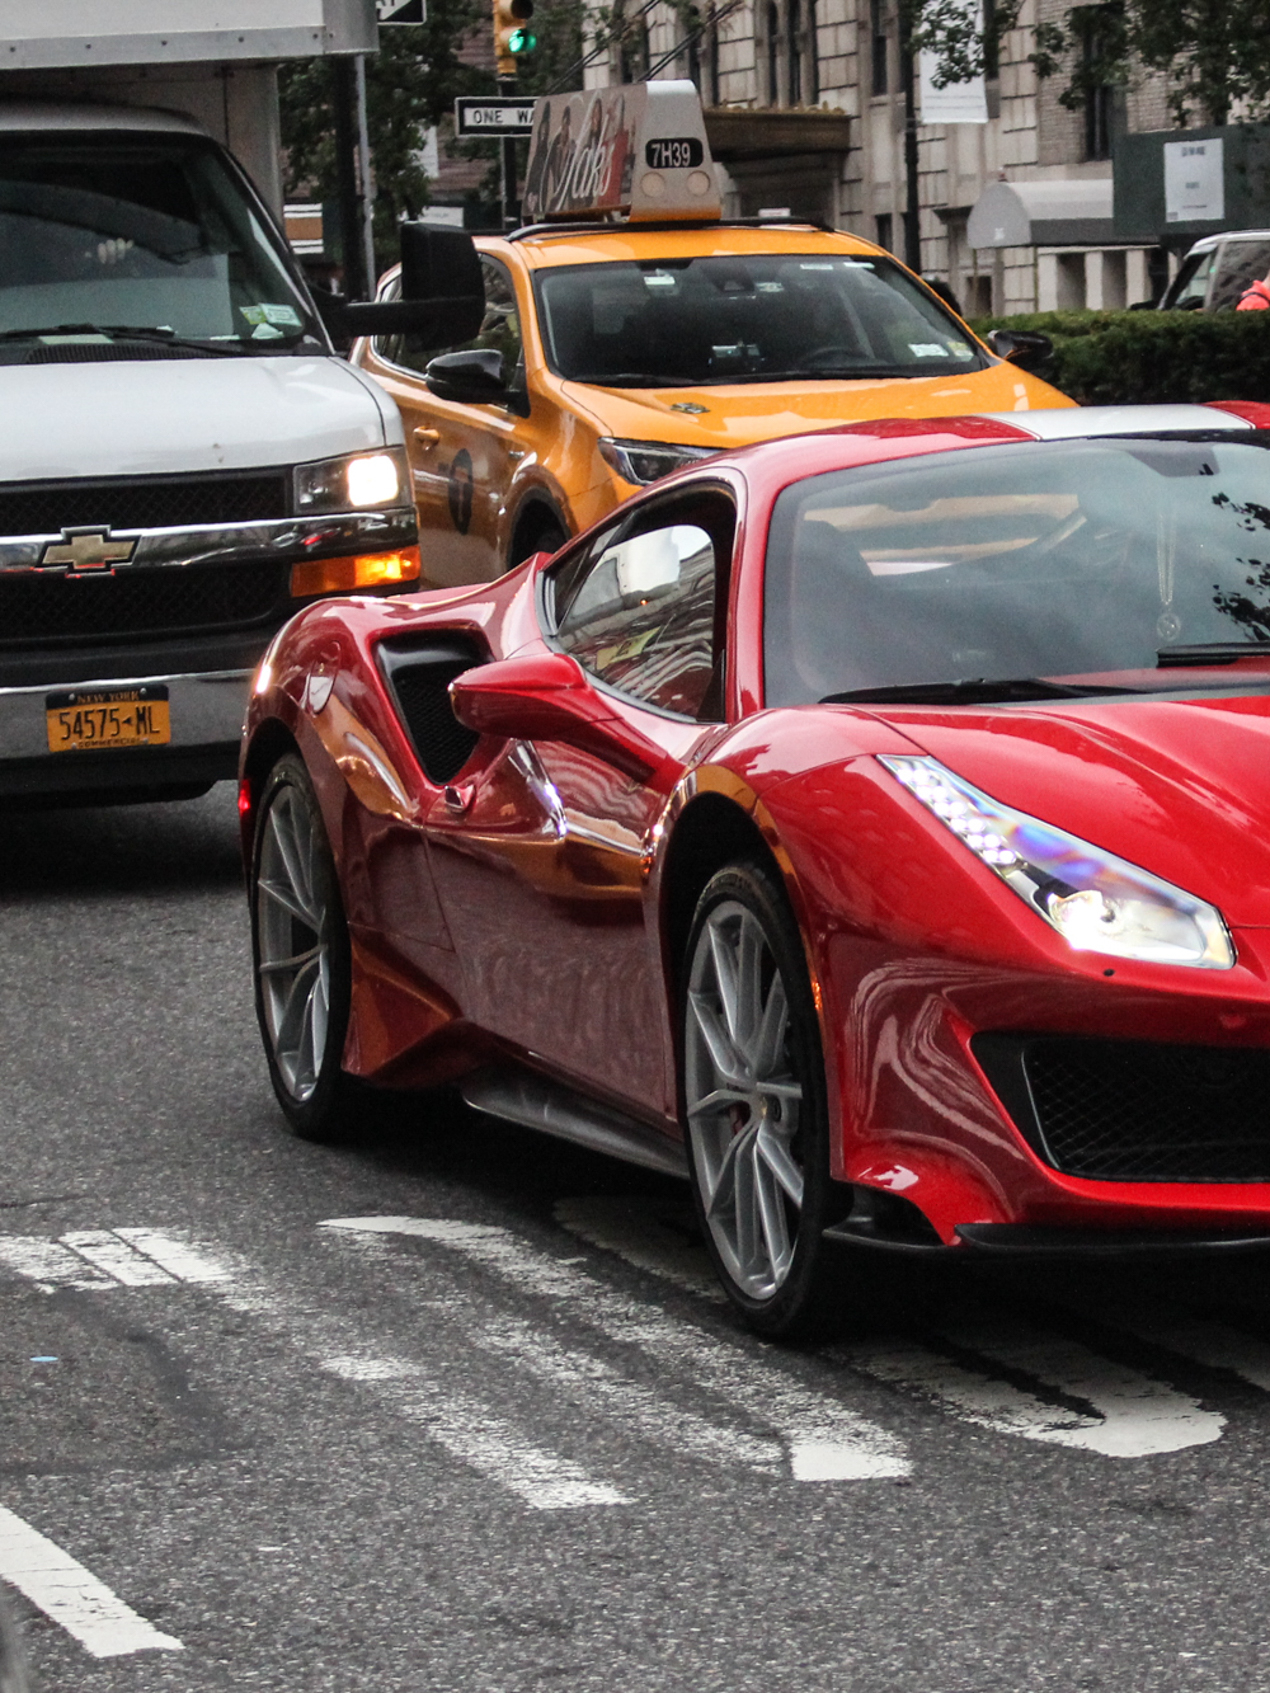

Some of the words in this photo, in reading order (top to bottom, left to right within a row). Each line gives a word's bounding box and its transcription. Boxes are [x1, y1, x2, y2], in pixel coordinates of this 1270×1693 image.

[473, 109, 503, 124] ONE
[652, 142, 692, 168] 7H39
[77, 694, 106, 704] NEW
[109, 690, 140, 702] YORK
[59, 708, 120, 741] 54575
